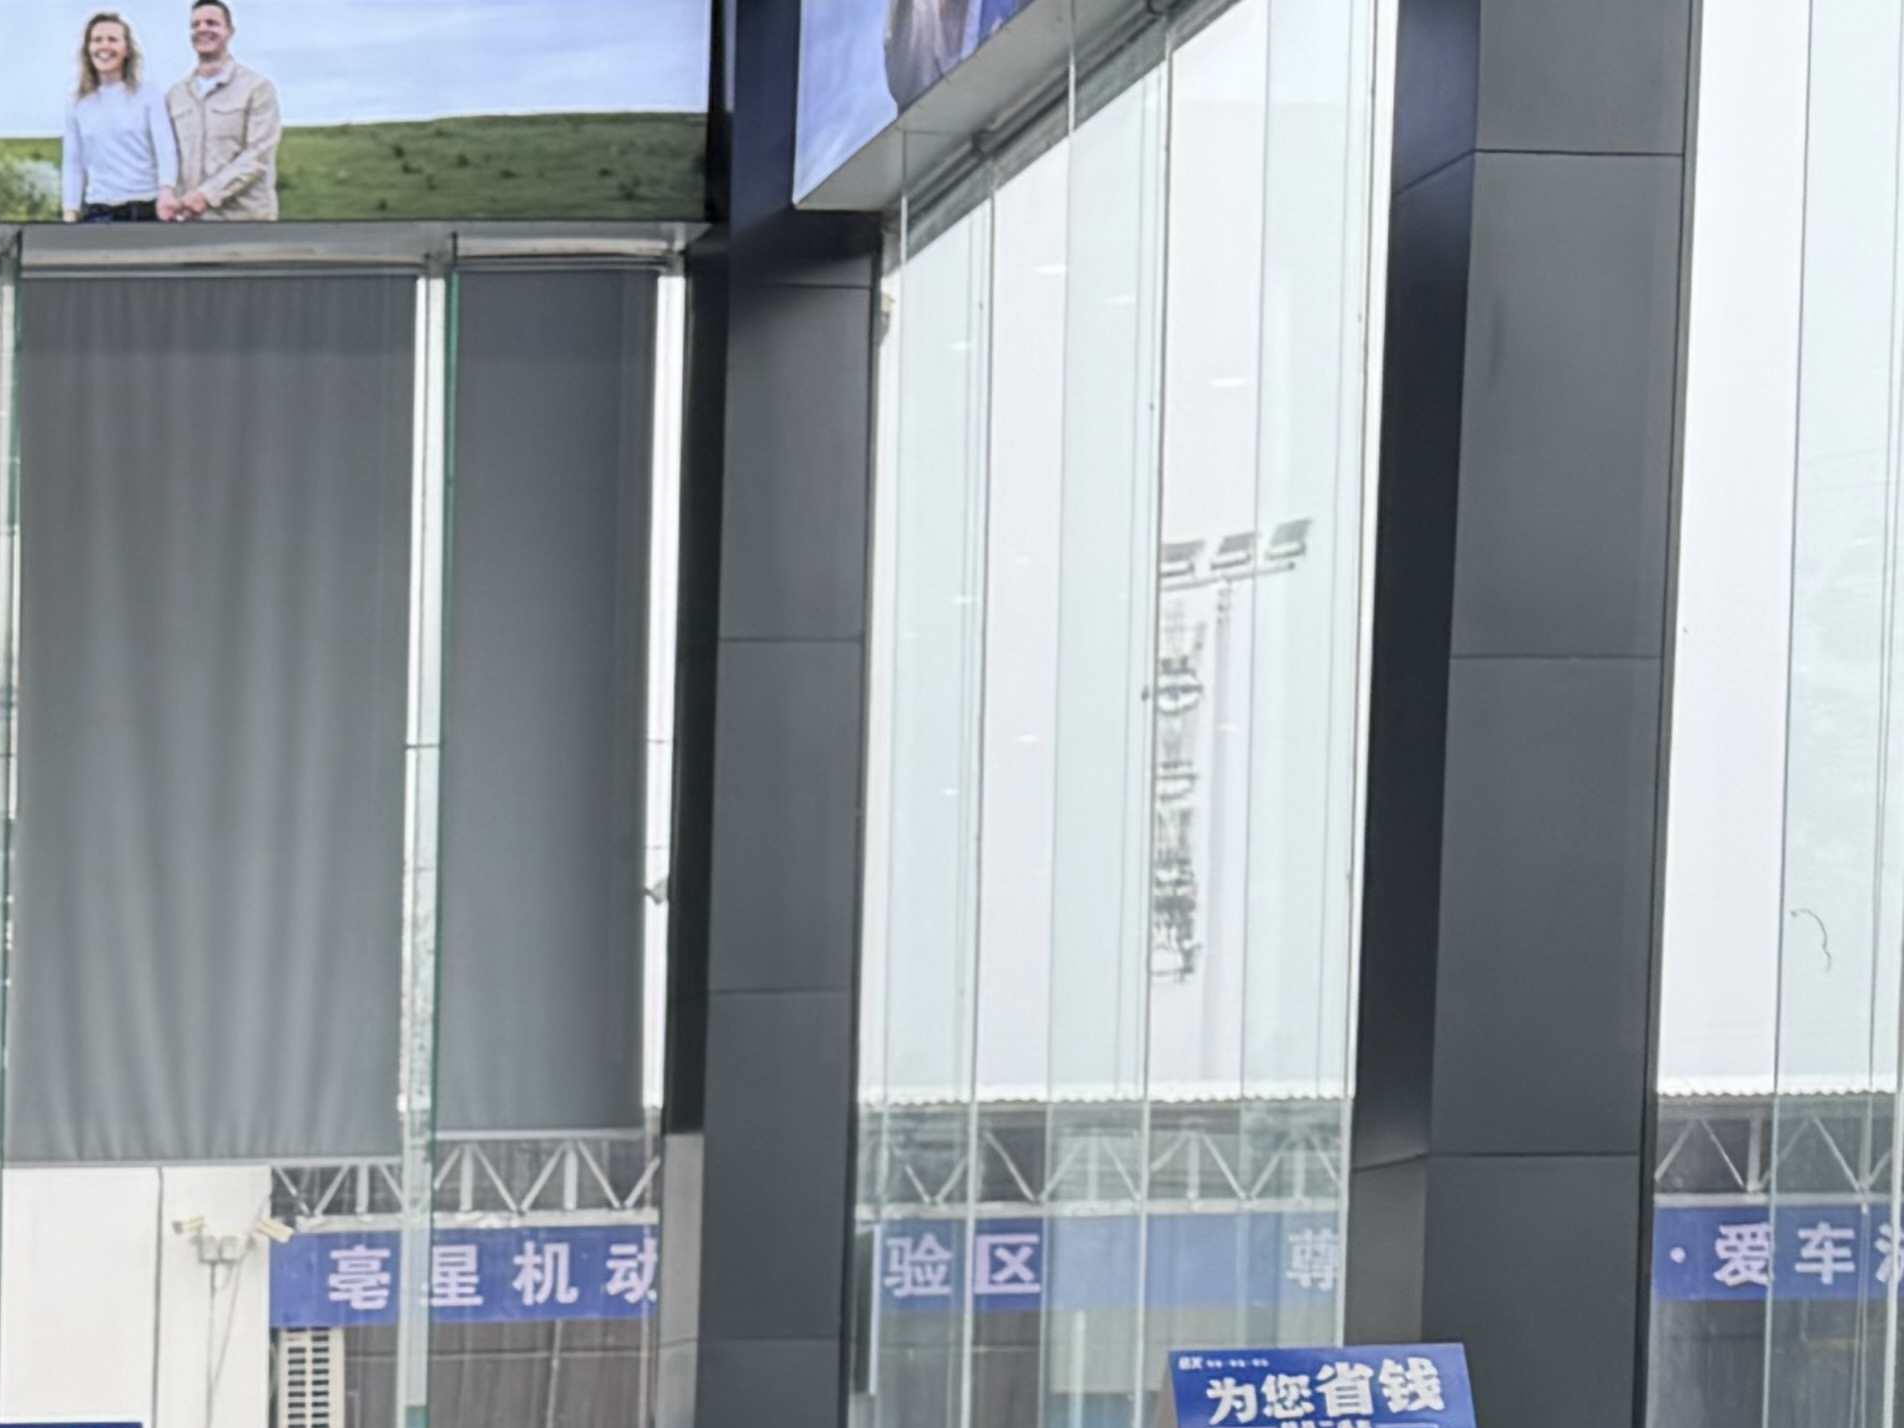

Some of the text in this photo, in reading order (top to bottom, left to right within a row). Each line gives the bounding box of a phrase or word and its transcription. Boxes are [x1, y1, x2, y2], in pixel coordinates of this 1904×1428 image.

[884, 1232, 1042, 1298] 验区
[1206, 1356, 1445, 1425] 为您省钱
